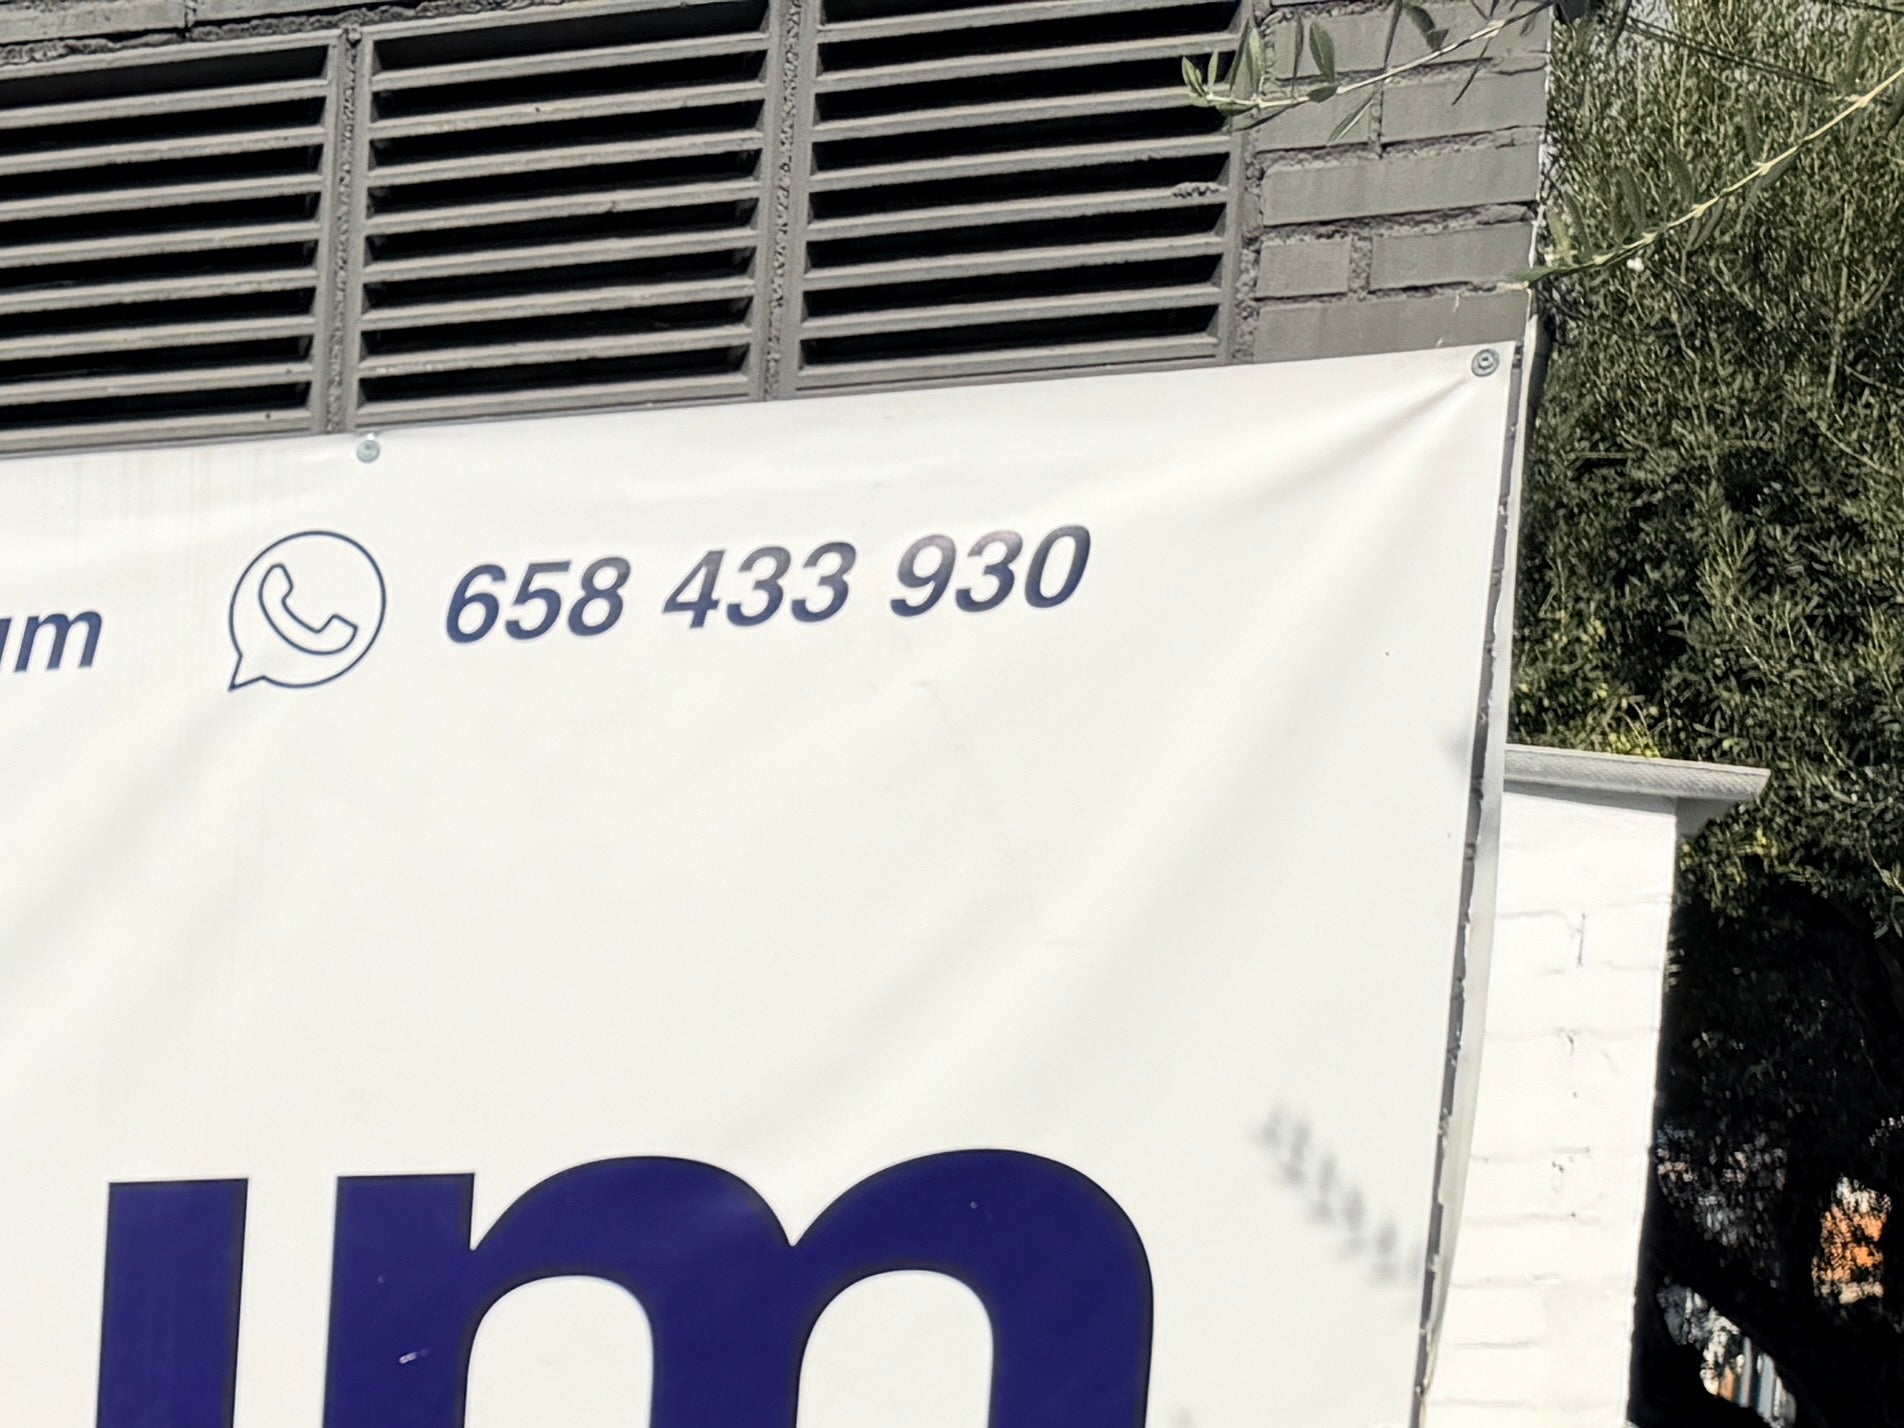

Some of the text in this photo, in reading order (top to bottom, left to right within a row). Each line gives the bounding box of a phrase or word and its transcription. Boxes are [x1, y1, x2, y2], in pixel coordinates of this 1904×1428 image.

[444, 524, 1094, 643] 658 433 930
